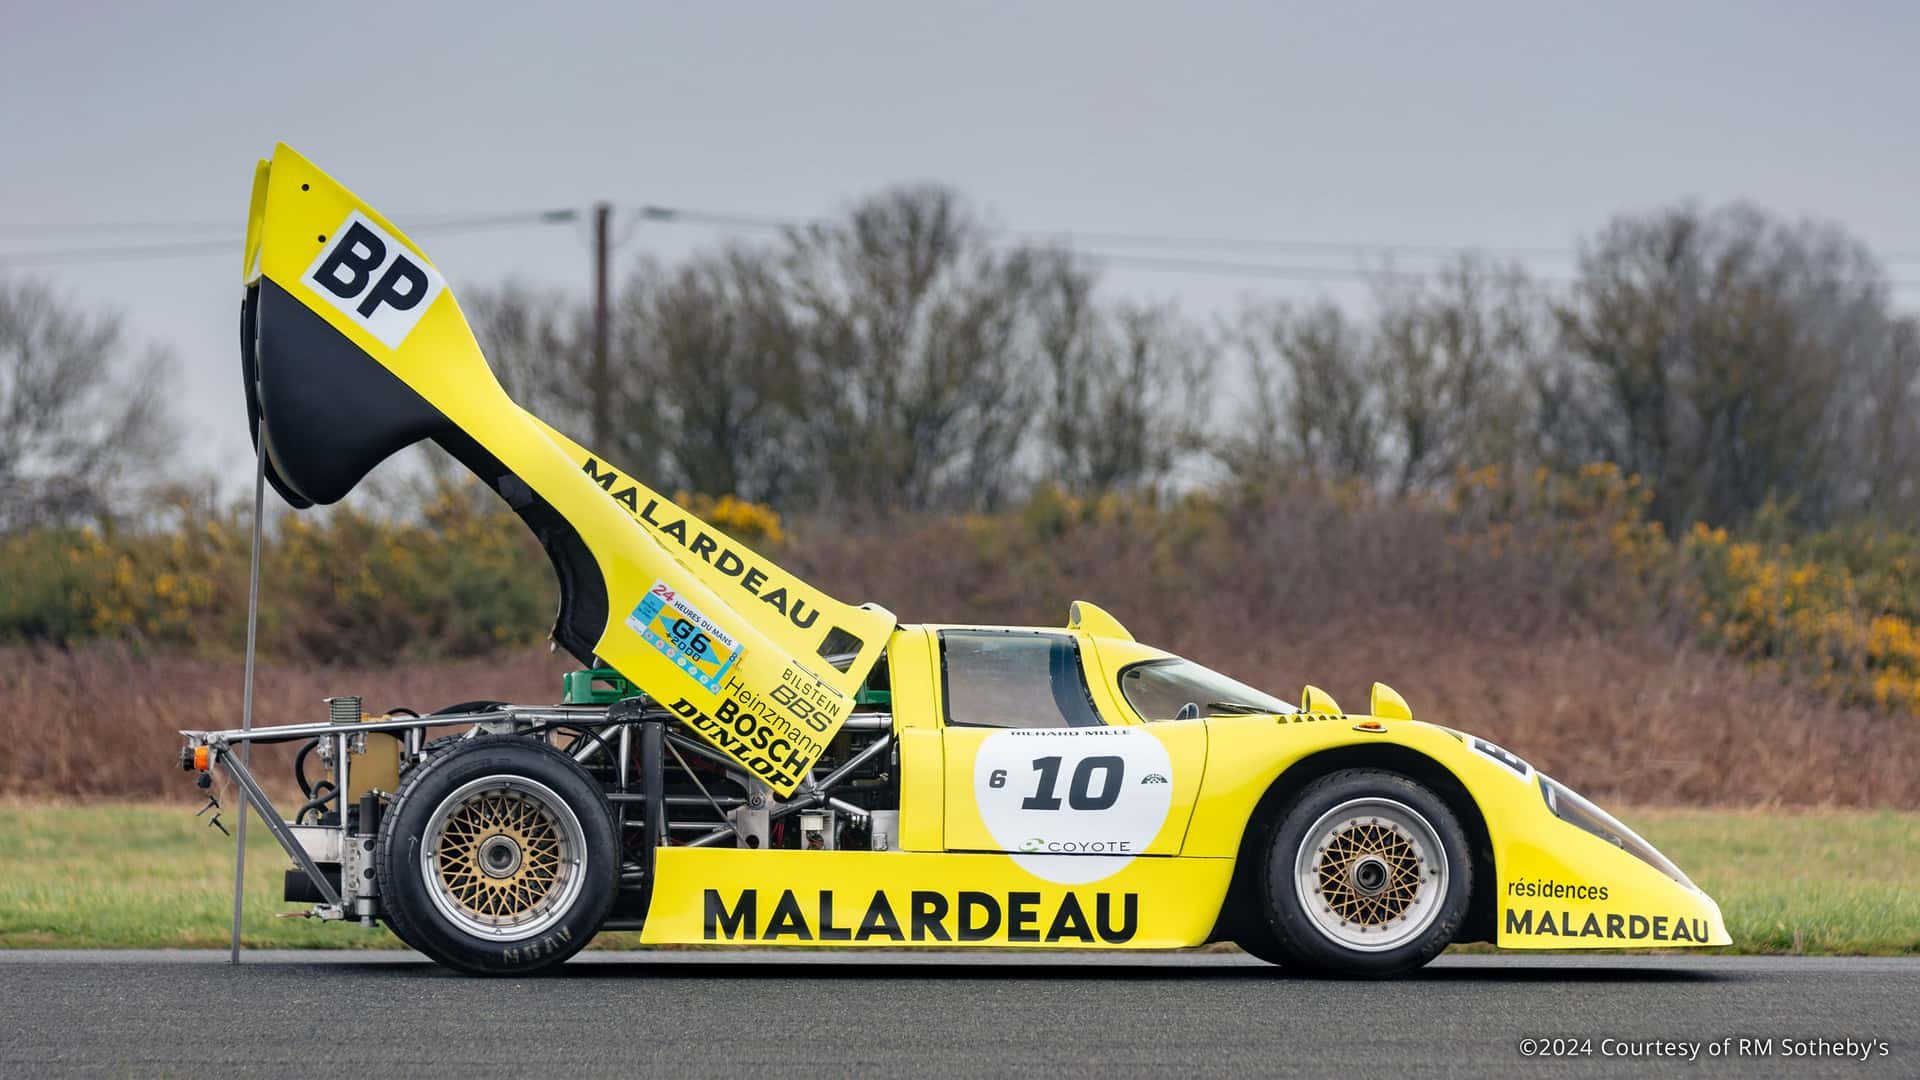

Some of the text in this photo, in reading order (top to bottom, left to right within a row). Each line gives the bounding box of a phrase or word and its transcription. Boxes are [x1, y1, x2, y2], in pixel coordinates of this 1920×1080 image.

[312, 220, 428, 319] BP
[582, 458, 820, 629] MALARDEAU
[652, 584, 675, 601] 24
[674, 601, 701, 623] HEURES
[700, 620, 713, 631] DU
[711, 627, 733, 646] MANS
[672, 618, 711, 654] G6
[724, 675, 823, 758] Heinzmann
[769, 684, 833, 732] BBS
[782, 668, 840, 717] BILSTEIN
[669, 697, 794, 788] DUNLOP
[714, 698, 809, 777] BOSCH
[989, 769, 1007, 788] 6
[1021, 756, 1125, 810] 10
[1048, 841, 1130, 852] COYOTE
[703, 889, 1138, 943] MALARDEAU
[1508, 878, 1609, 900] résidences
[1505, 909, 1709, 943] MALARDEAU
